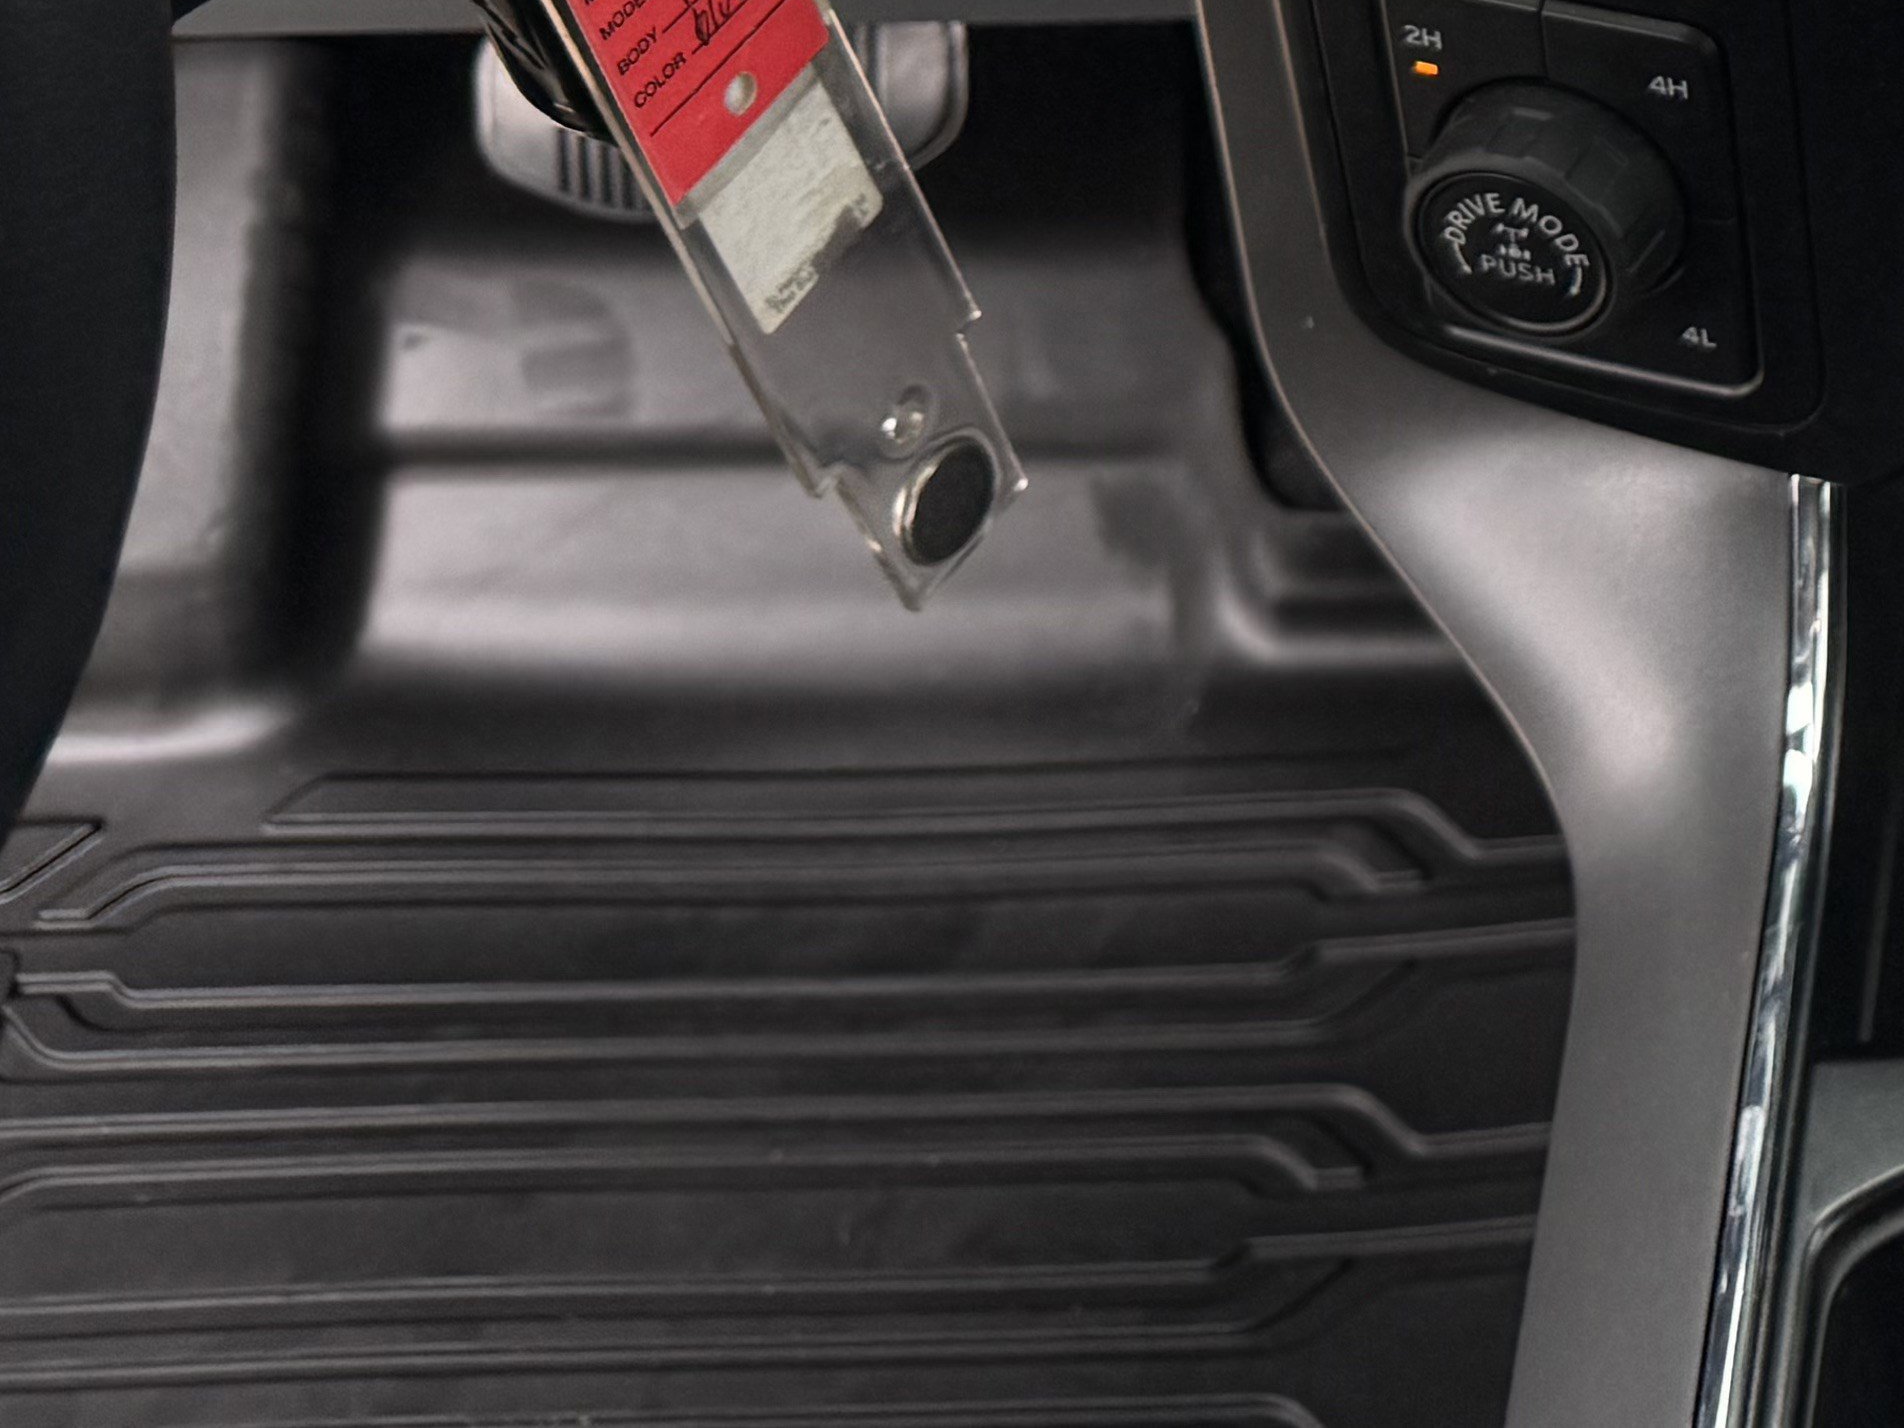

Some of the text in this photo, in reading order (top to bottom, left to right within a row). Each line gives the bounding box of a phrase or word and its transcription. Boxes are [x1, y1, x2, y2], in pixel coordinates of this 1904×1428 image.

[616, 27, 659, 76] BODY
[1404, 24, 1443, 51] 2H
[633, 51, 688, 109] COLOR
[1647, 75, 1690, 103] 4H
[1443, 192, 1591, 268] DRIVE MODE
[1480, 253, 1556, 286] PUSH
[1681, 325, 1718, 350] 4L
